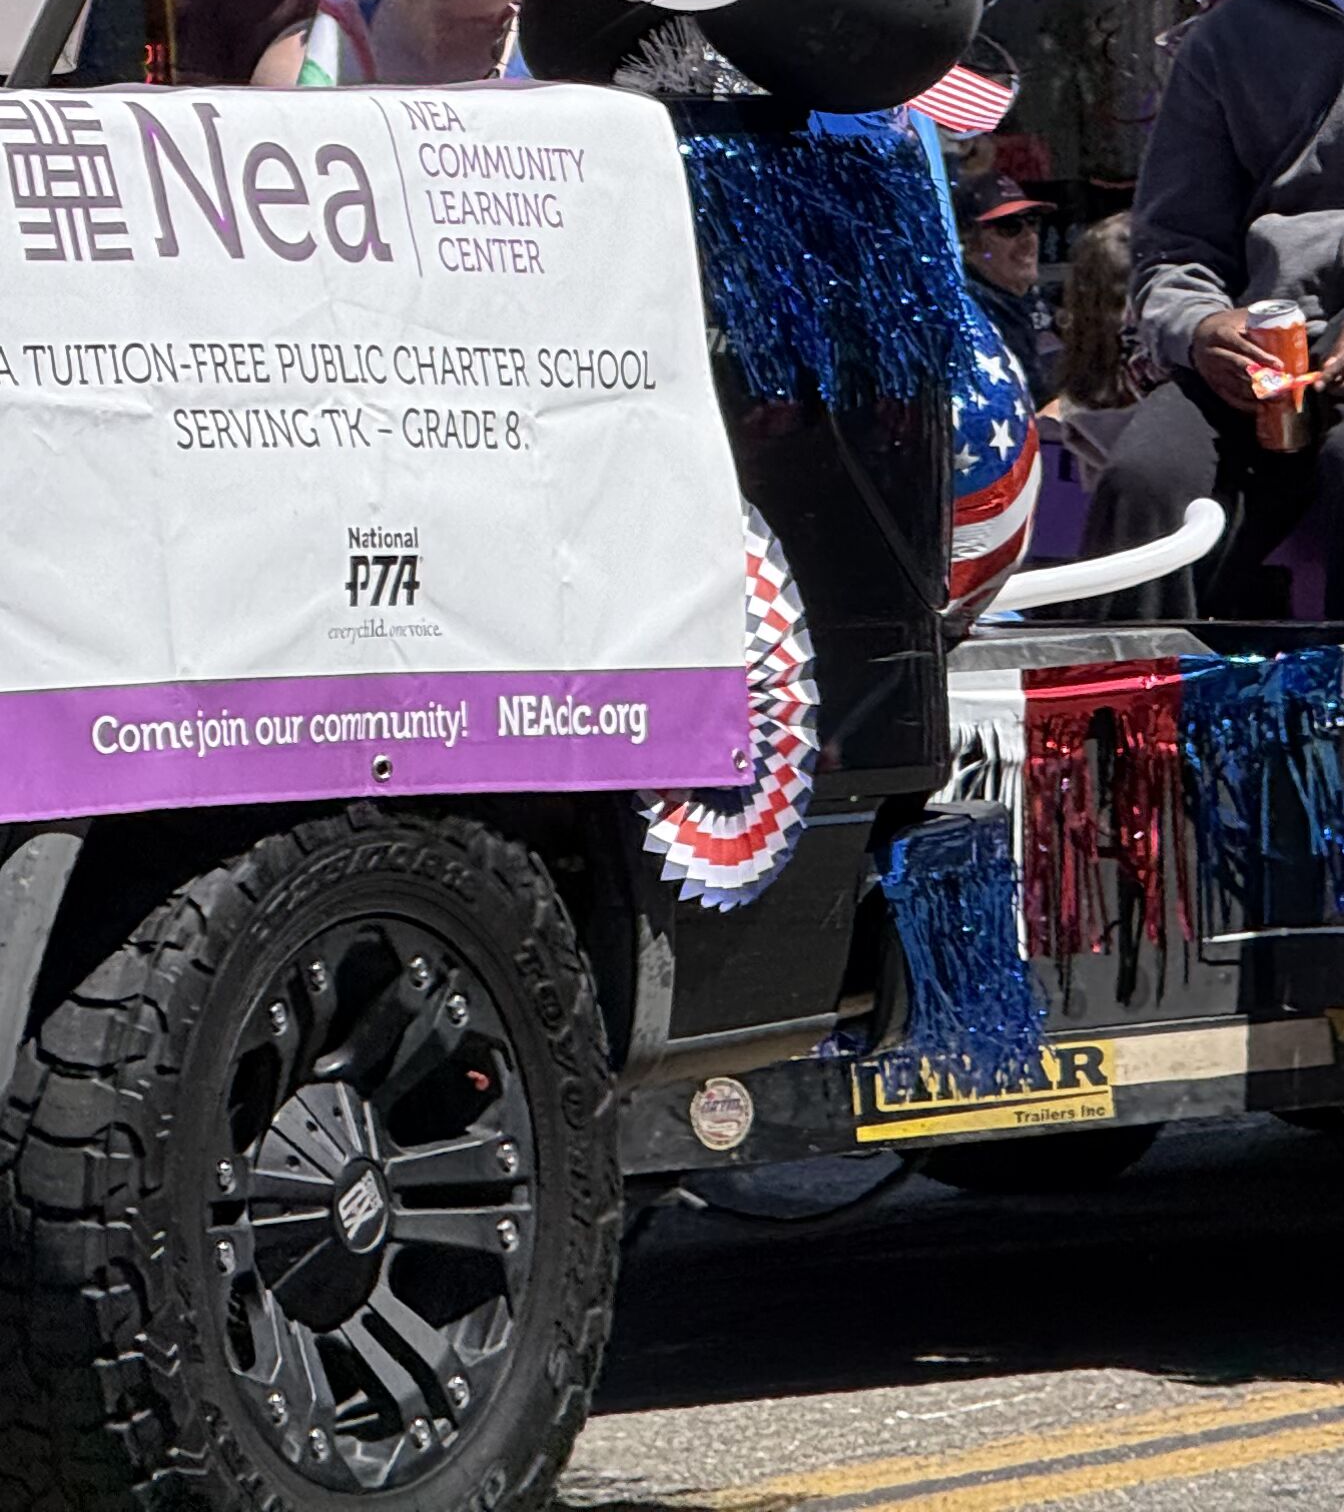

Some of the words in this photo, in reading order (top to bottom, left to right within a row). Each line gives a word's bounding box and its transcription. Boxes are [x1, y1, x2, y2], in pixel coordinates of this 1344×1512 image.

[400, 100, 465, 133] NEA
[123, 100, 393, 263] Nea
[419, 143, 586, 184] COMMUNITY
[426, 190, 564, 229] LEARNING
[438, 238, 546, 276] CENTER
[23, 342, 270, 387] TUITION-FREE
[278, 343, 386, 385] PUBLIC
[393, 344, 528, 388] CHARTER
[539, 349, 656, 391] SCHOOL
[175, 408, 319, 451] SERVING
[321, 408, 372, 449] TK
[402, 408, 498, 451] GRADE
[347, 526, 419, 549] National
[344, 554, 421, 607] PTA
[92, 714, 194, 755] Come
[196, 708, 250, 757] join
[255, 713, 304, 747] our
[310, 700, 470, 748] community!
[497, 694, 648, 744] NEAclc.org
[1014, 1107, 1076, 1124] Trailers
[1080, 1104, 1106, 1118] Inc
